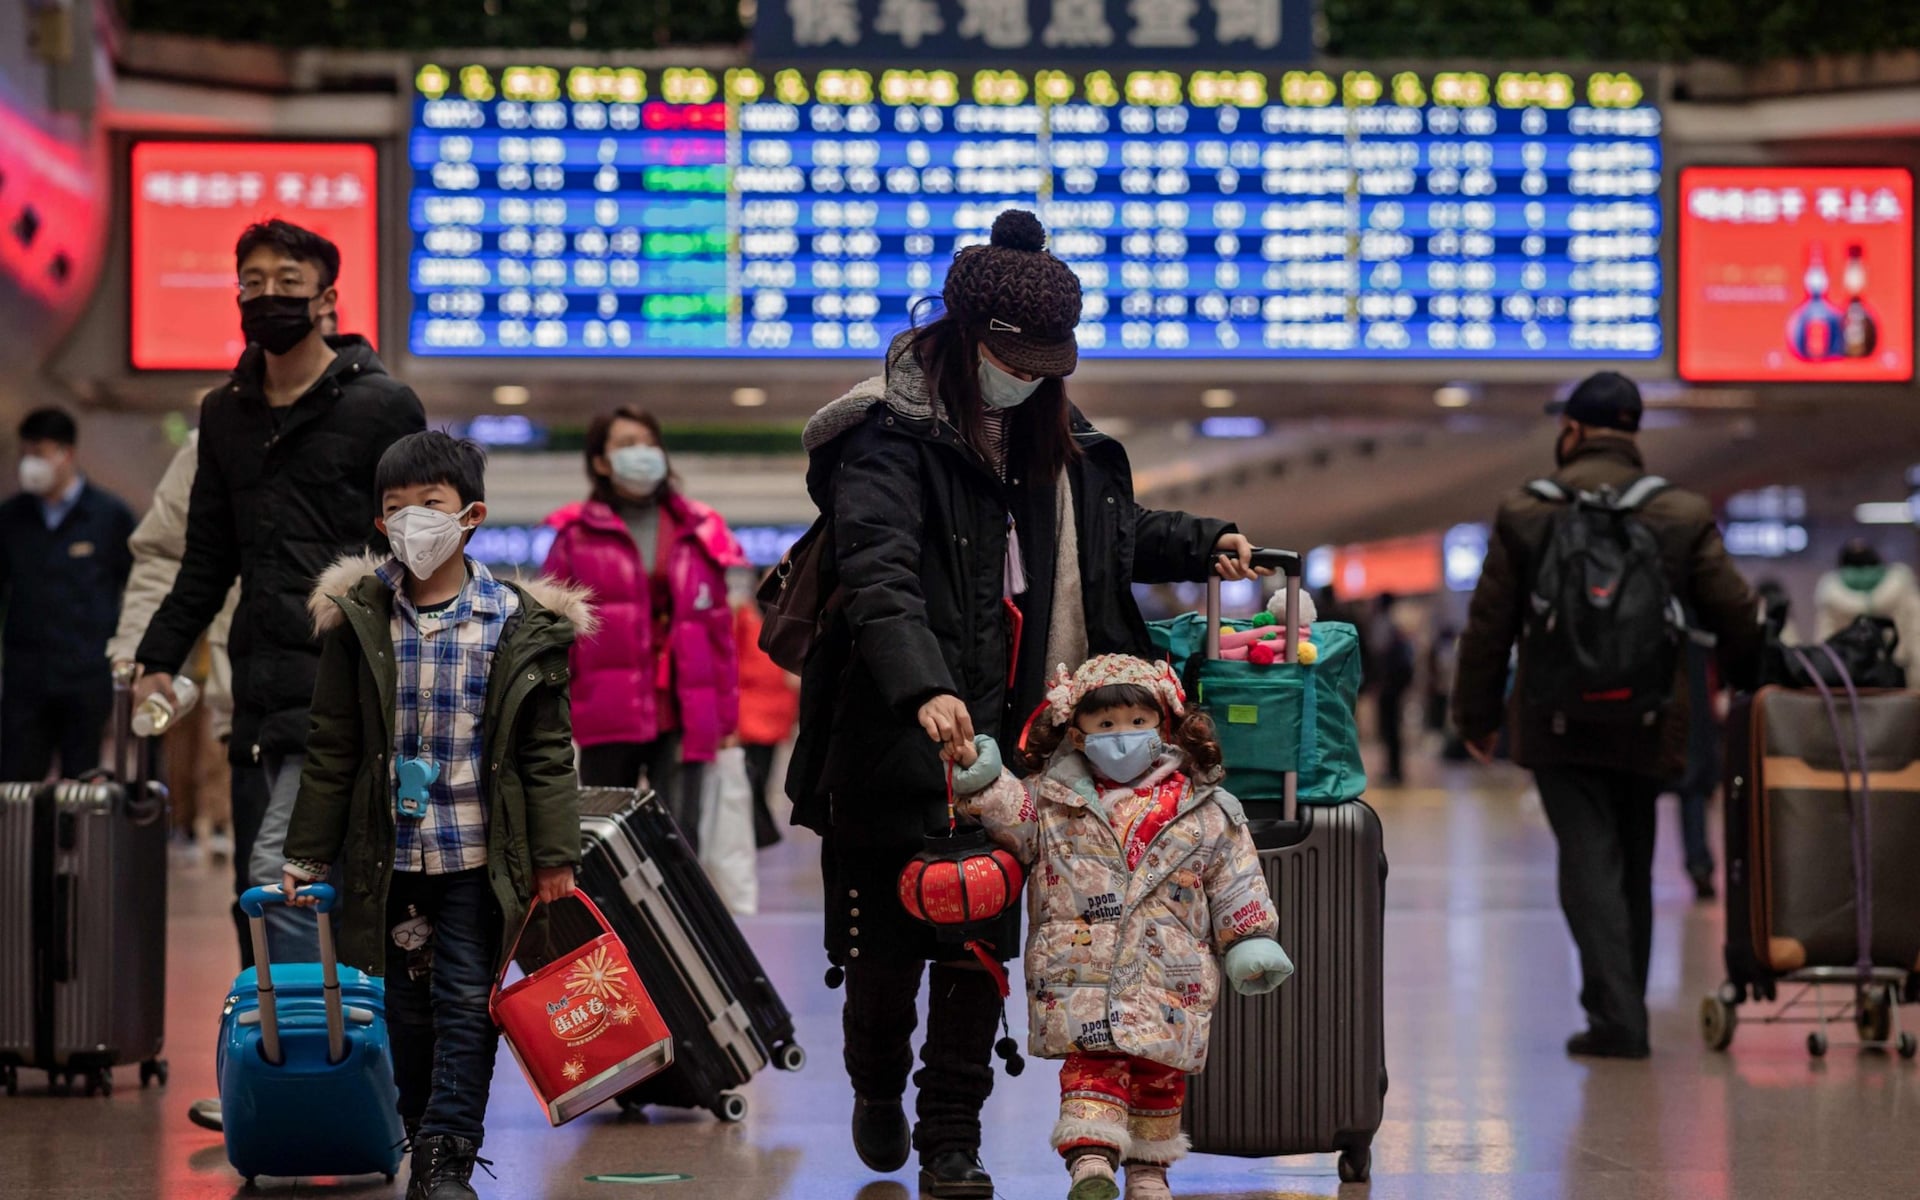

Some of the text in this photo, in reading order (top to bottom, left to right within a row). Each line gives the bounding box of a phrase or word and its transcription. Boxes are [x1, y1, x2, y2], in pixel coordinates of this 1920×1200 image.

[1232, 911, 1267, 934] irector
[555, 997, 604, 1034] 蛋酥卷
